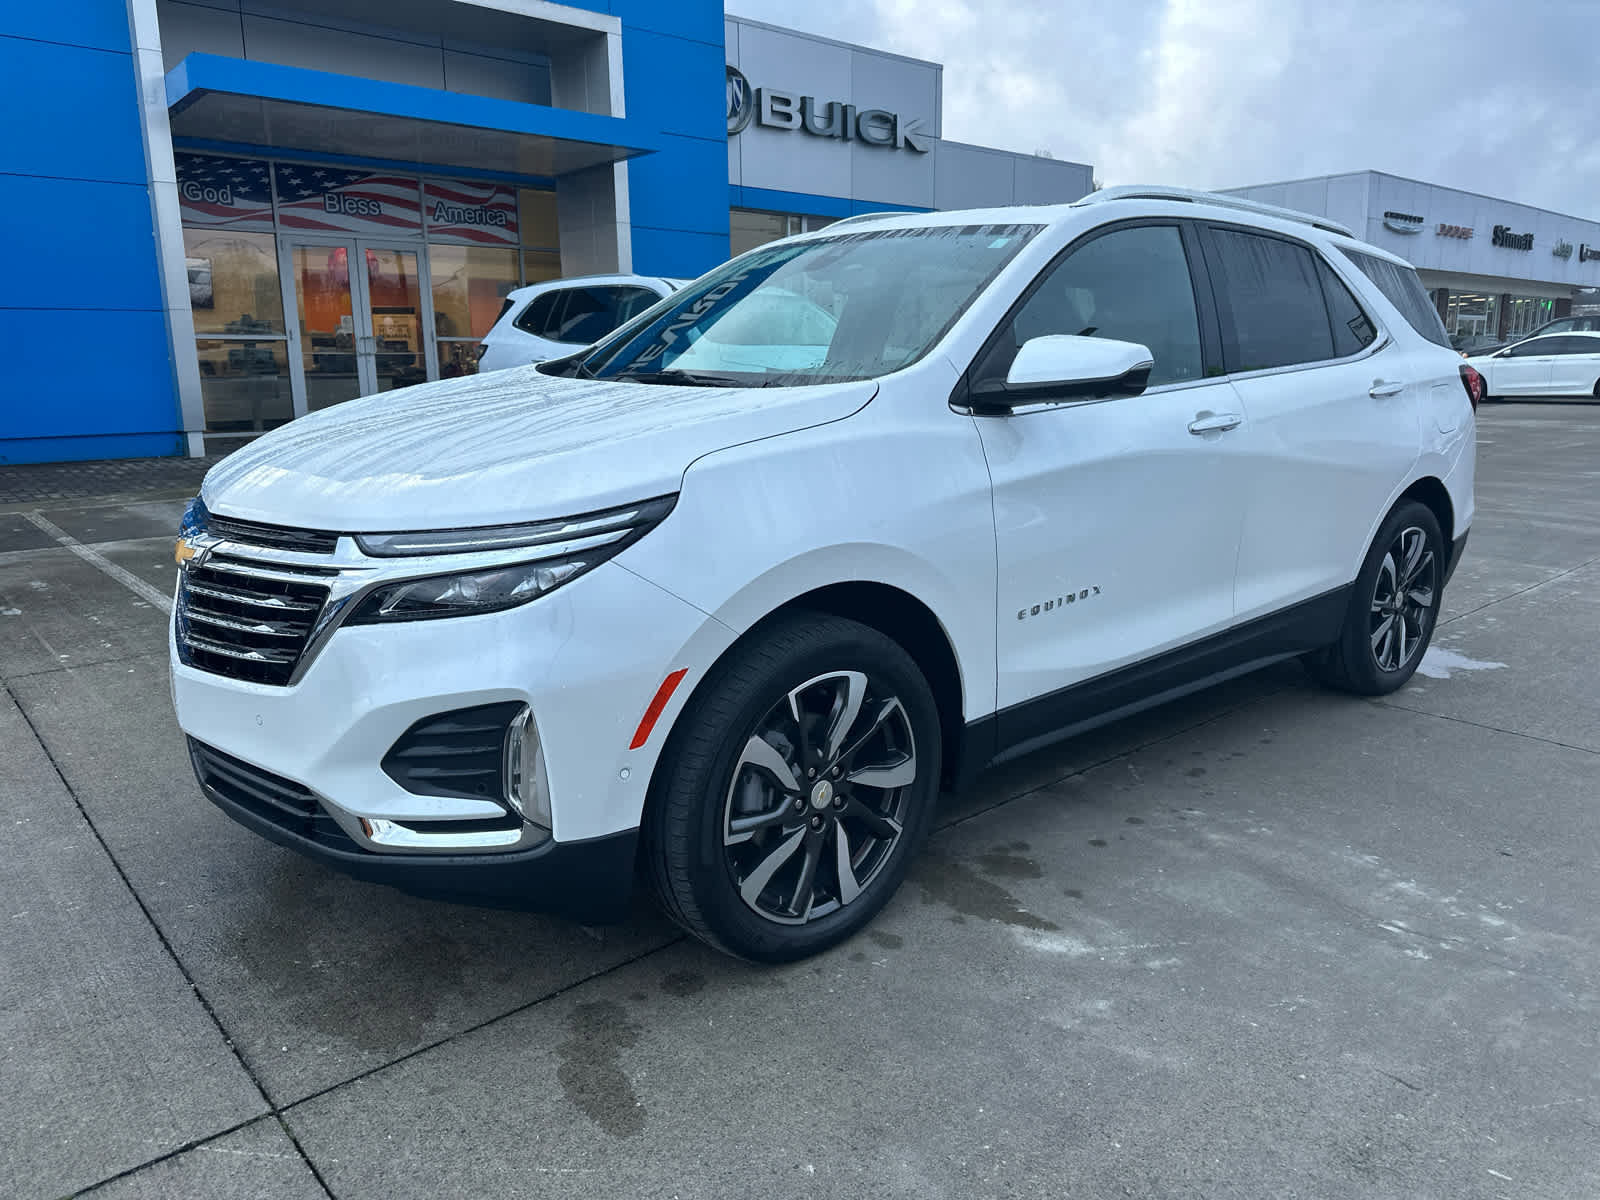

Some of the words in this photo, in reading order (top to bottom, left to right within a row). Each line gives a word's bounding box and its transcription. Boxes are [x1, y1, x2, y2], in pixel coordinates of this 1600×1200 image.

[755, 87, 928, 153] BUICK
[182, 180, 233, 205] God
[323, 193, 381, 216] Bless
[433, 202, 507, 225] America
[1017, 586, 1101, 620] EQUINOX
